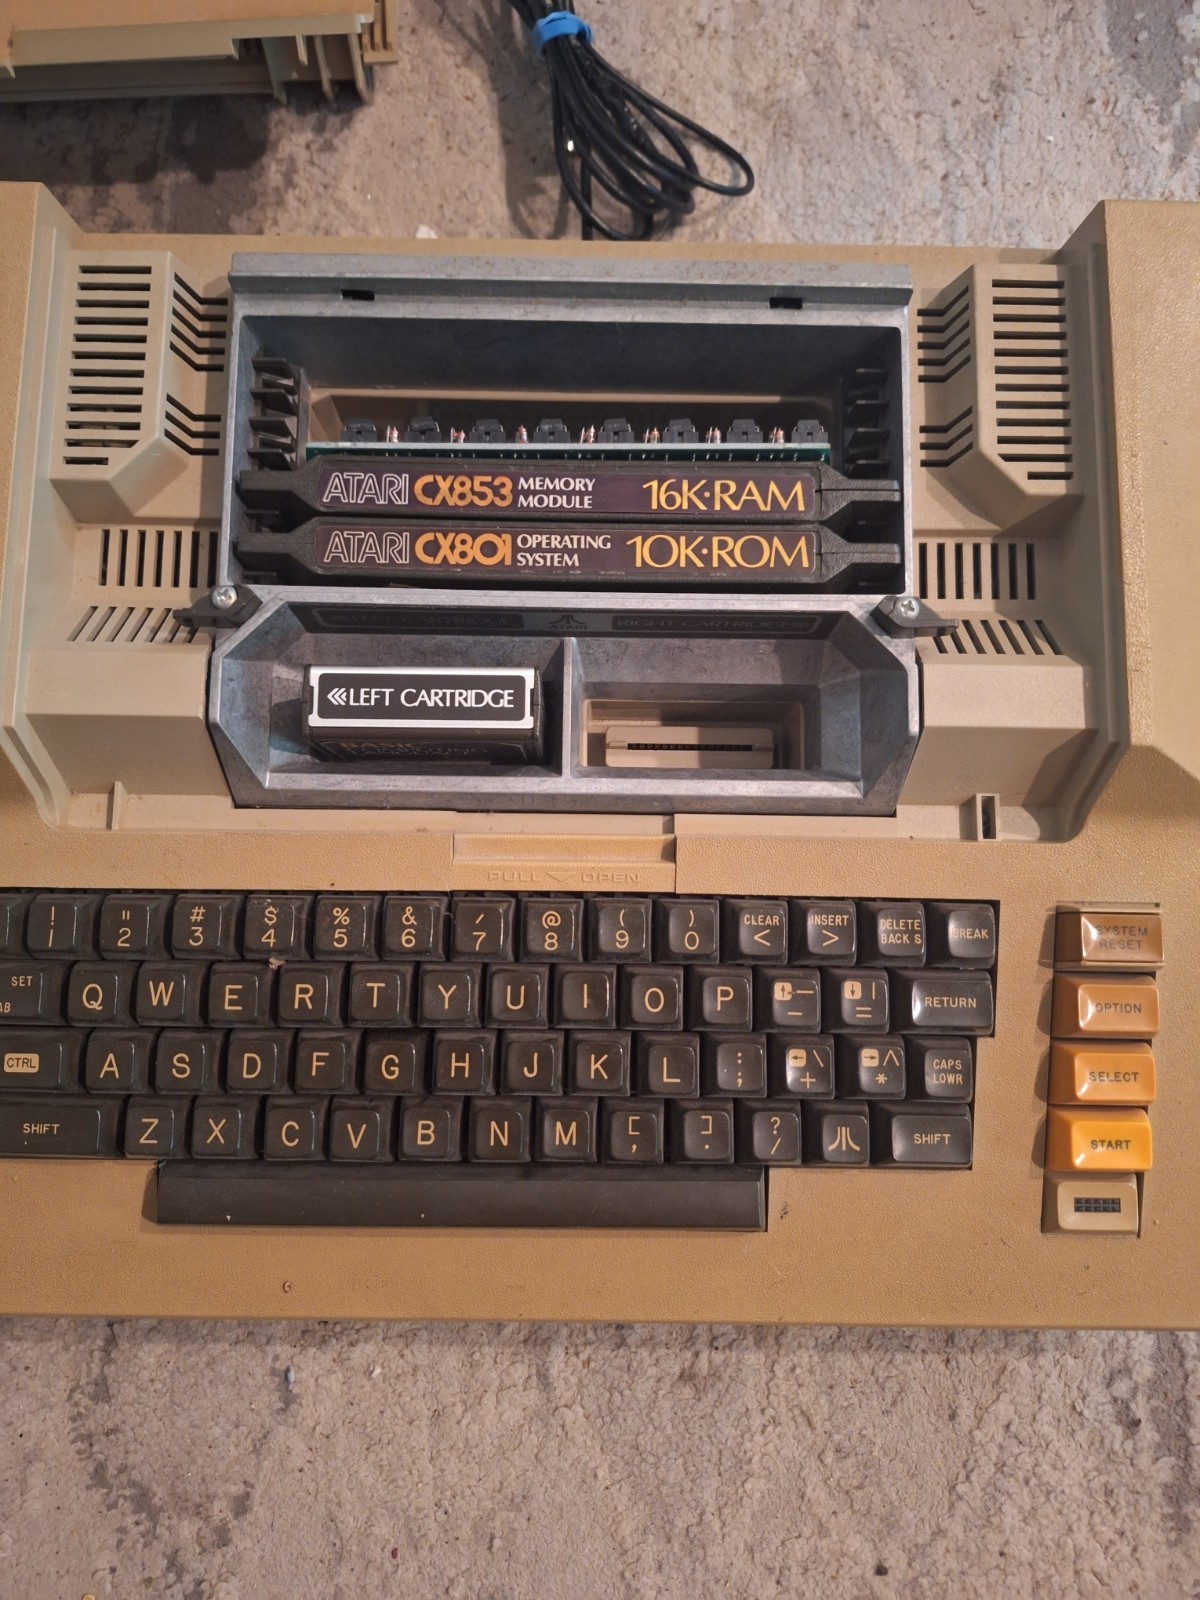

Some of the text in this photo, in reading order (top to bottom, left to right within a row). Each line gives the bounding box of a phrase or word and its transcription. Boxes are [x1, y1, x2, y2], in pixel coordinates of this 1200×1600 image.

[322, 472, 513, 507] ATARI CX853
[518, 476, 596, 492] MEMORY
[518, 494, 593, 509] MODULE
[323, 531, 512, 566] ATARI CX801
[517, 533, 612, 550] OPERATING
[516, 552, 580, 567] SYSTEM
[349, 688, 515, 708] LEFT CARTRIDGE
[487, 871, 641, 883] PULL OPEN
[190, 905, 206, 922] #
[264, 905, 277, 926] $
[333, 907, 350, 926] %
[401, 906, 418, 926] &
[541, 910, 561, 929] @
[619, 909, 626, 927] (
[689, 910, 695, 927] )
[743, 914, 780, 926] CLEAR
[810, 915, 849, 926] INSERT
[880, 919, 921, 930] DELETE
[952, 927, 989, 939] BREAK
[1095, 925, 1148, 936] SYSTEM
[117, 928, 131, 947] 2
[188, 927, 204, 946] 3
[261, 928, 277, 947] 4
[333, 929, 348, 948] 5
[401, 928, 416, 948] 6
[472, 931, 487, 951] 7
[544, 932, 558, 951] 8
[615, 930, 629, 949] 9
[881, 933, 922, 945] BACK S
[1100, 939, 1142, 950] RESET
[11, 975, 33, 987] SET
[82, 983, 103, 1011] Q
[149, 980, 174, 1006] W
[224, 985, 243, 1011] E
[294, 983, 314, 1010] R
[366, 982, 386, 1008] T
[438, 984, 457, 1009] Y
[506, 985, 525, 1010] U
[644, 988, 665, 1013] O
[717, 986, 734, 1012] P
[925, 997, 977, 1008] RETURN
[855, 1006, 872, 1018] =
[1095, 1002, 1142, 1014] OPTION
[6, 1057, 37, 1069] CTRL
[100, 1053, 120, 1079] A
[172, 1053, 191, 1079] S
[243, 1053, 262, 1078] D
[311, 1052, 330, 1077] F
[381, 1054, 400, 1080] G
[450, 1053, 470, 1078] H
[523, 1052, 538, 1078] J
[590, 1053, 609, 1080] K
[663, 1057, 681, 1083] L
[933, 1059, 962, 1071] CAPS
[800, 1071, 816, 1088] +
[933, 1073, 963, 1085] LOWR
[1088, 1071, 1139, 1083] SELECT
[22, 1123, 60, 1135] SHIFT
[139, 1118, 159, 1144] Z
[206, 1118, 227, 1144] X
[281, 1121, 300, 1146] C
[416, 1120, 435, 1145] B
[490, 1121, 509, 1146] N
[555, 1121, 577, 1146] M
[771, 1116, 781, 1135] ?
[347, 1123, 367, 1149] V
[913, 1133, 951, 1145] SHIFT
[1090, 1139, 1131, 1150] START
